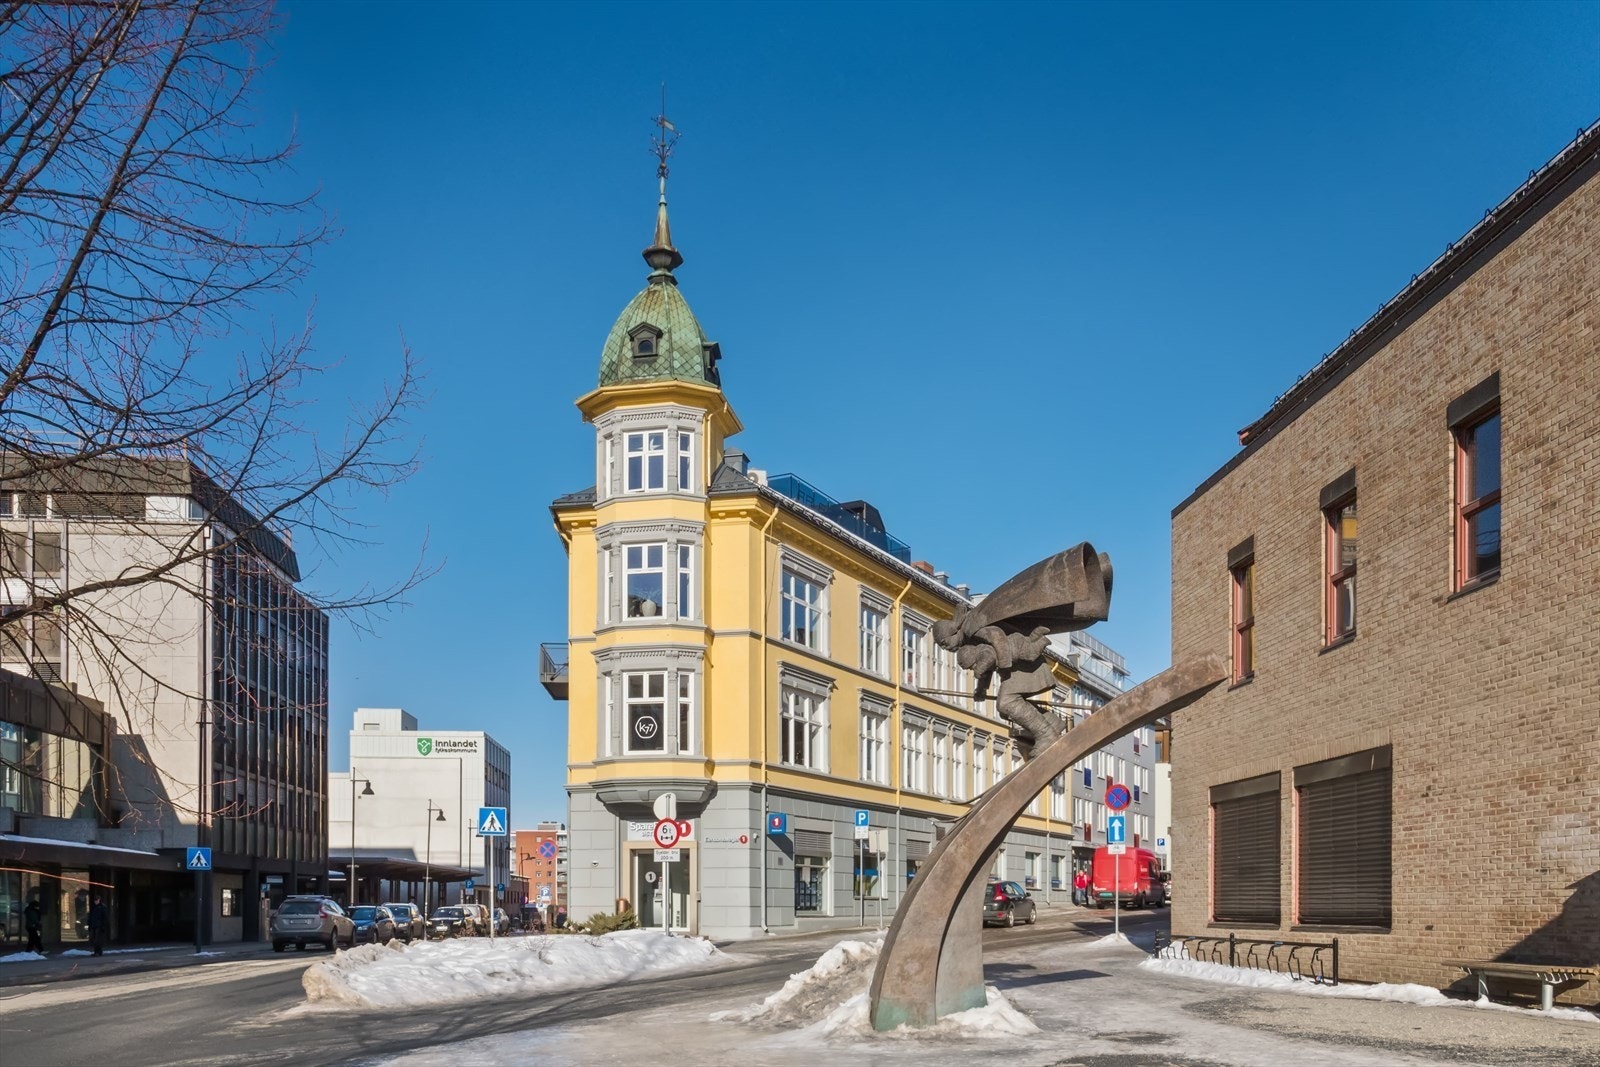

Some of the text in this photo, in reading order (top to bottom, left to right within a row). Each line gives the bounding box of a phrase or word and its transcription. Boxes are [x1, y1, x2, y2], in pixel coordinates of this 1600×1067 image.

[435, 739, 478, 748] Innlandet
[858, 812, 866, 825] P
[630, 821, 656, 832] Spare
[662, 825, 668, 834] 6
